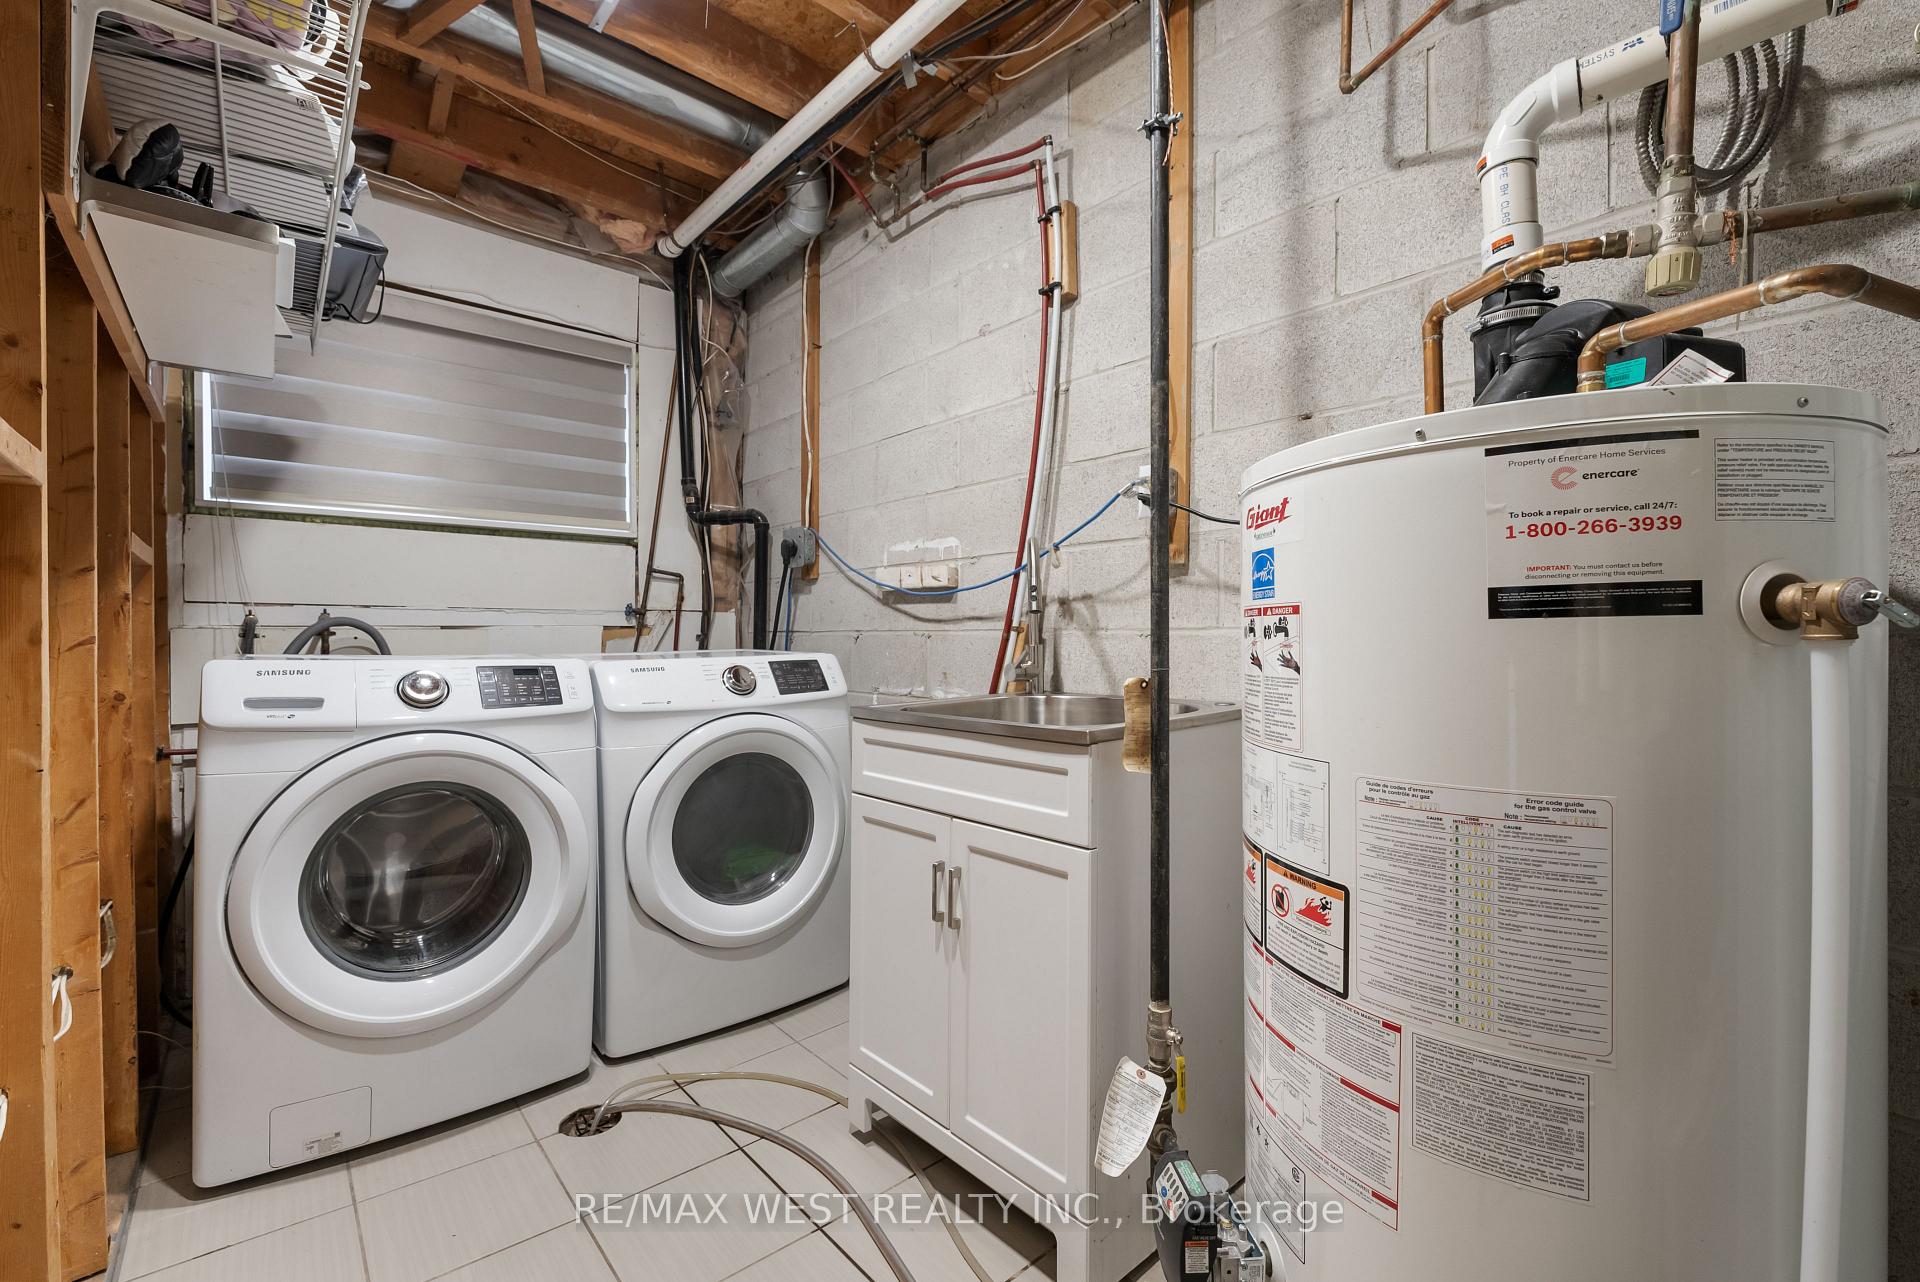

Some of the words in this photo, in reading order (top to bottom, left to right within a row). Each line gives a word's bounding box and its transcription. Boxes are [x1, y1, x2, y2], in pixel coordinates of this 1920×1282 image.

[1508, 459, 1545, 468] Property
[1548, 456, 1557, 464] of
[1559, 453, 1597, 462] Enercare
[1600, 450, 1626, 458] Home
[1628, 448, 1666, 456] Services
[1582, 468, 1638, 480] enercare
[1246, 497, 1291, 530] Giant
[1521, 509, 1544, 518] book
[1553, 507, 1582, 516] repair
[1595, 504, 1632, 513] service,
[1634, 502, 1650, 511] call
[1652, 502, 1678, 510] 24/7:
[1505, 516, 1682, 540] 1-800-266-3939
[1525, 572, 1571, 580] disconnecting
[1580, 570, 1612, 578] removing
[1626, 568, 1665, 577] equipment.
[1526, 564, 1572, 572] IMPORTANT:
[1272, 606, 1294, 615] DANGER
[256, 669, 312, 677] SAMSUNG
[1290, 874, 1317, 890] WARNING
